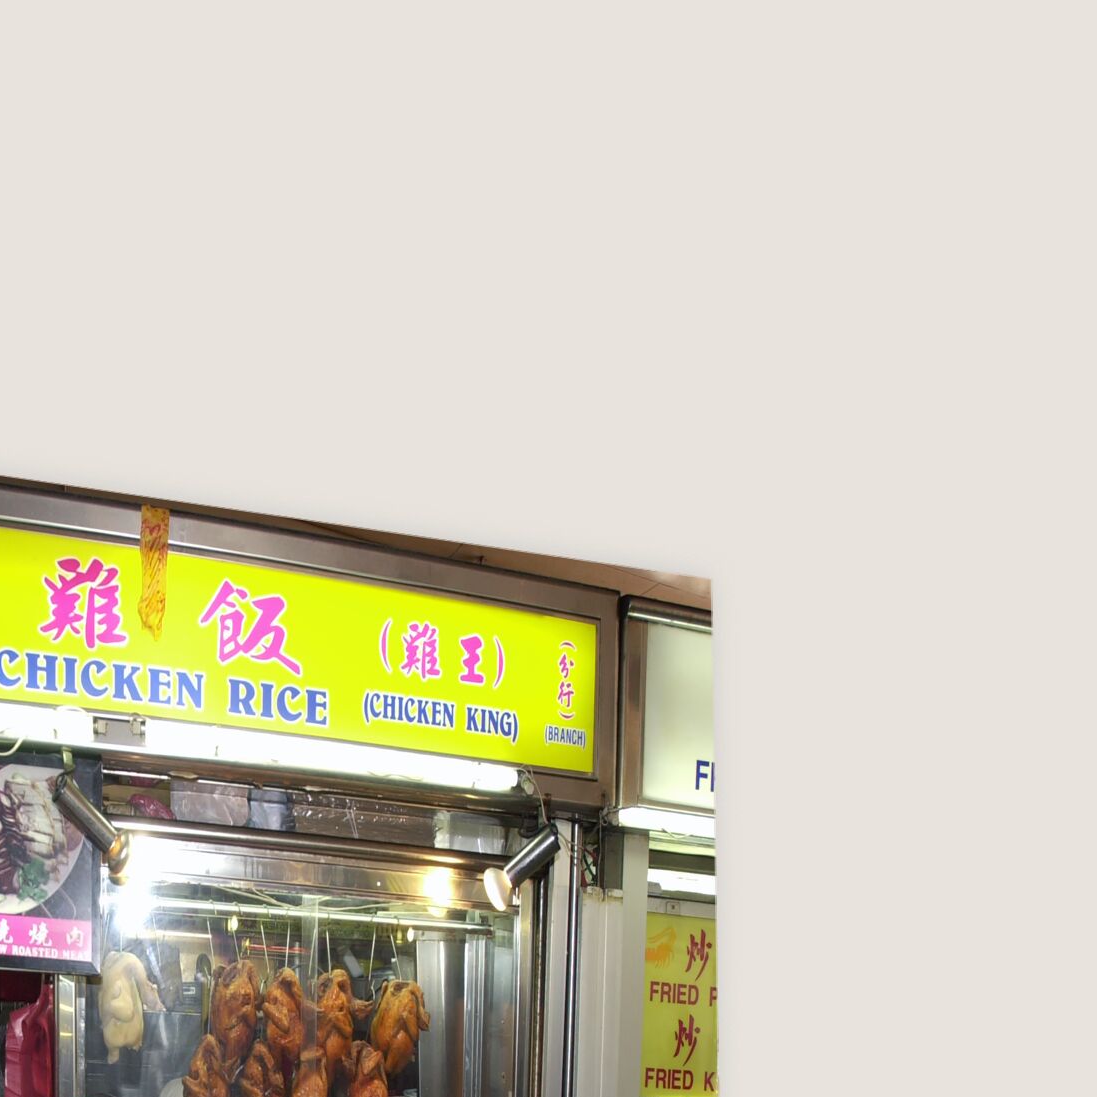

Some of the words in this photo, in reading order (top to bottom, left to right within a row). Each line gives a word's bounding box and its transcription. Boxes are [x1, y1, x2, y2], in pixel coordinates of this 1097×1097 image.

[228, 678, 328, 726] RICE
[364, 693, 454, 728] (CHICKEN
[466, 707, 518, 742] KING)
[545, 725, 586, 748] (BRANCH)
[11, 946, 58, 959] ROASTED
[649, 981, 699, 1006] FRIED
[644, 1067, 694, 1090] FRIED
